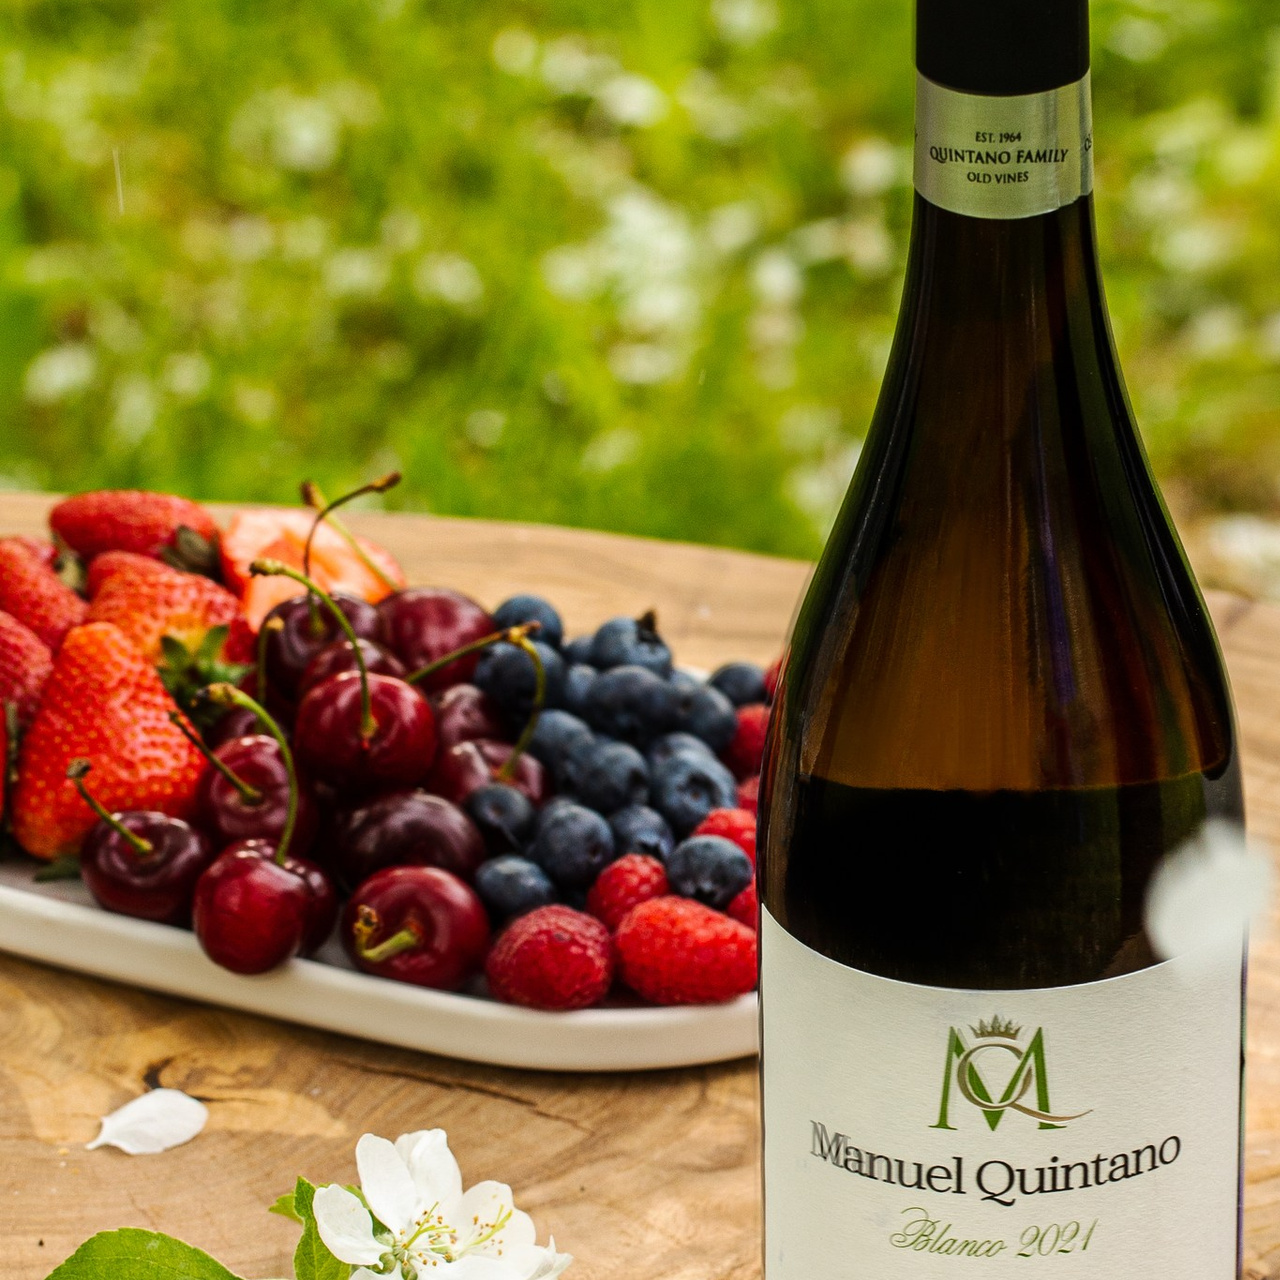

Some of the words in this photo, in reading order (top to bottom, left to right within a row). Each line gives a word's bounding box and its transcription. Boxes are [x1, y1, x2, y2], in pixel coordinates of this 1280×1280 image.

[975, 131, 996, 143] EST.
[1000, 131, 1022, 143] 1964
[930, 146, 1011, 164] QUINTANO
[1016, 149, 1069, 163] FAMILY
[967, 171, 992, 184] OLD
[995, 171, 1029, 184] VINES
[810, 1119, 967, 1195] Manuel
[976, 1135, 1182, 1207] Quintano
[889, 1207, 1009, 1258] Blanco
[1016, 1218, 1100, 1258] 2021
